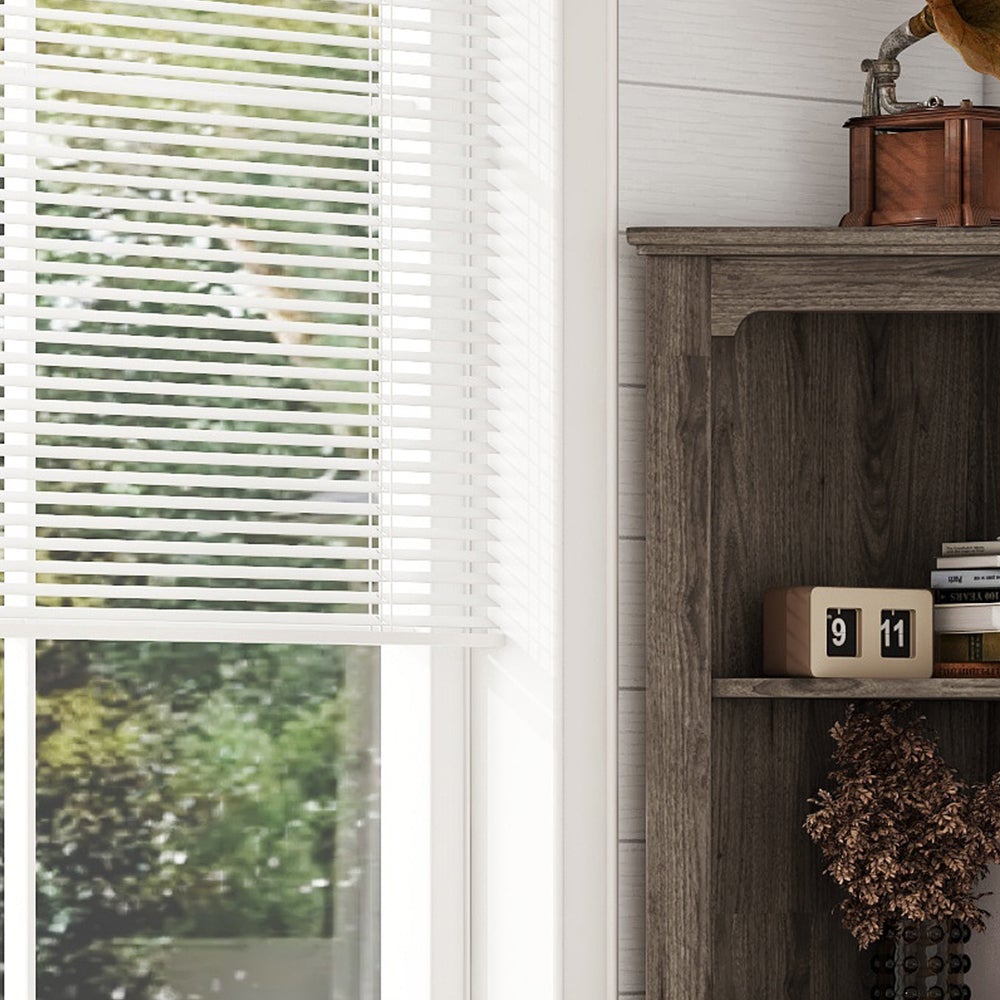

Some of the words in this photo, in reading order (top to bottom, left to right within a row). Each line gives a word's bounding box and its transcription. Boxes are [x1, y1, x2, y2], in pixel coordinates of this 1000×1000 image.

[950, 592, 983, 601] YEARS
[984, 591, 999, 600] 100
[831, 617, 846, 647] 9
[881, 619, 904, 647] 11
